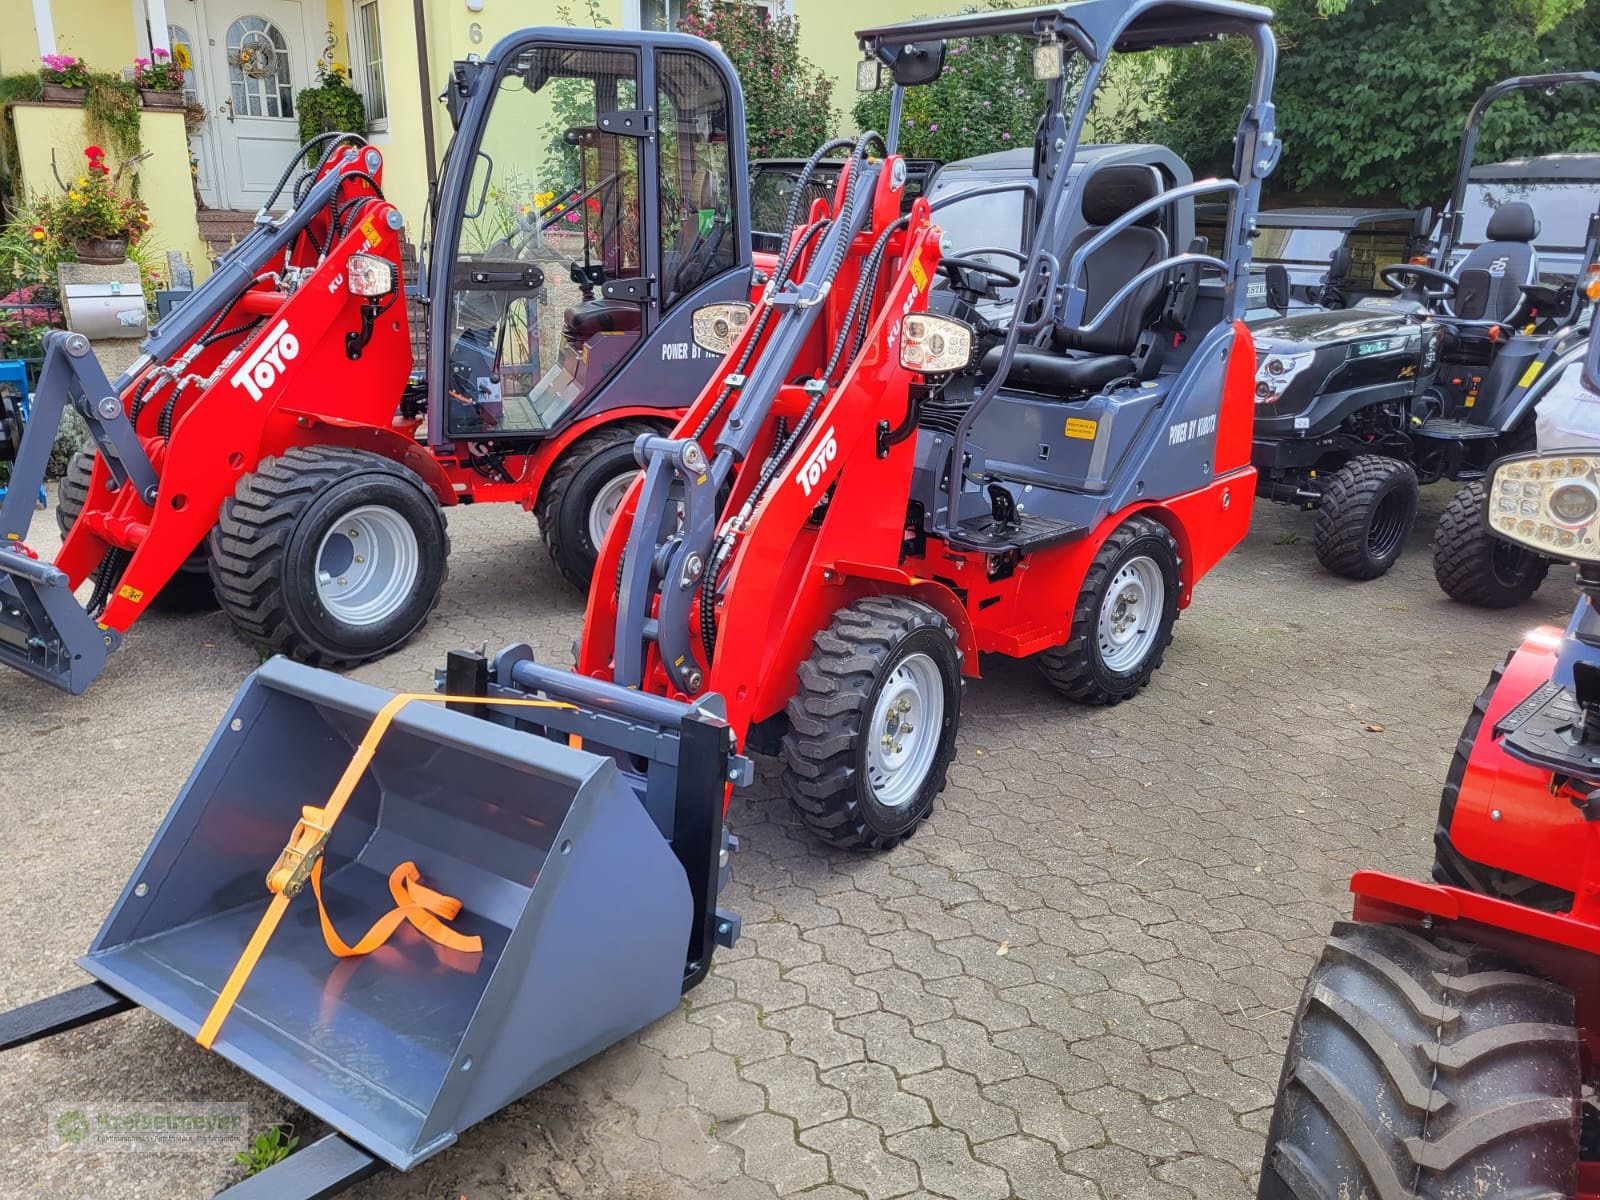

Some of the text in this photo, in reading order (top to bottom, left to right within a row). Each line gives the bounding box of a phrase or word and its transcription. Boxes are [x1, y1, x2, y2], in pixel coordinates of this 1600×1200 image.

[469, 22, 482, 44] 6
[328, 273, 343, 294] KU
[888, 319, 900, 348] KU
[230, 318, 299, 402] TOYO
[662, 343, 688, 360] POWER
[1169, 413, 1216, 446] POWER BY KUBOTA
[796, 425, 837, 496] TOYO
